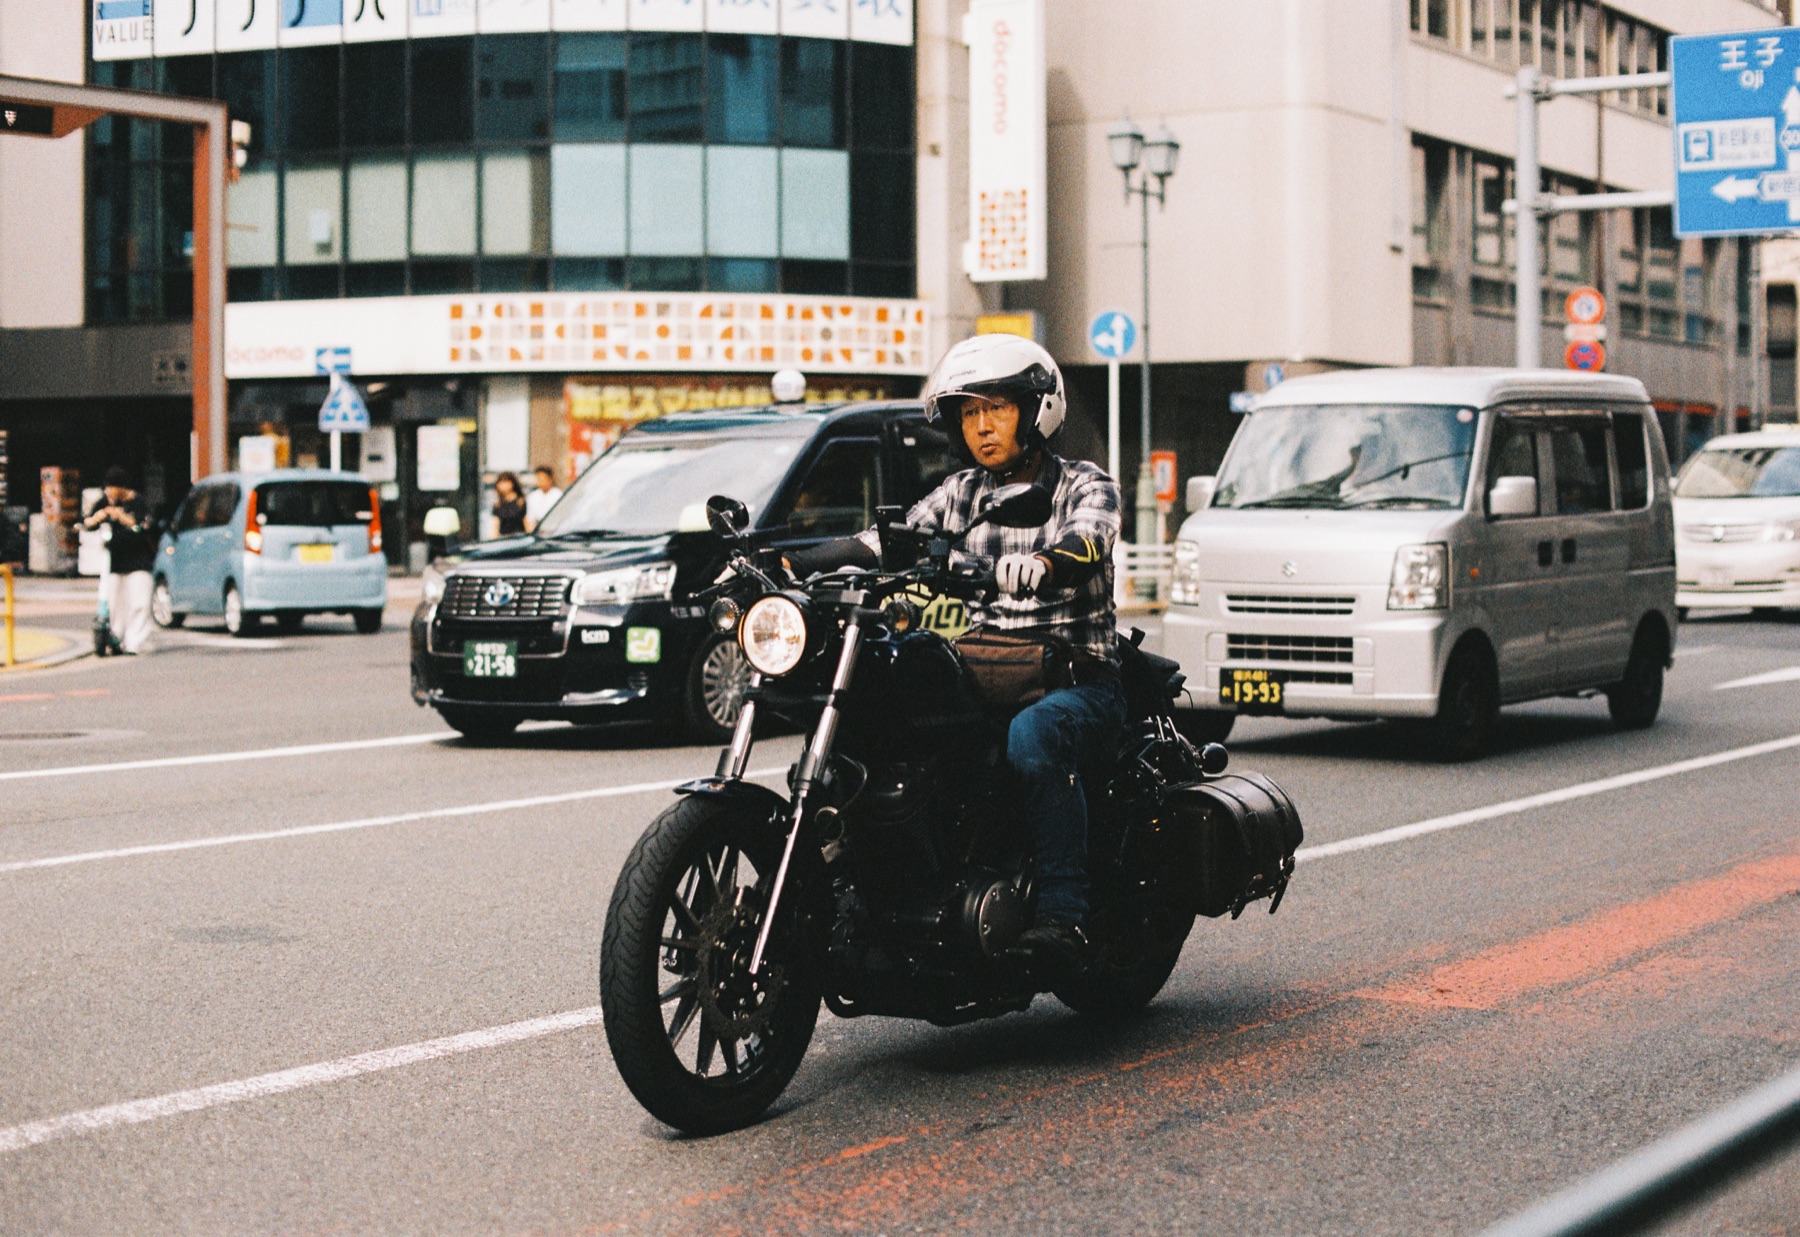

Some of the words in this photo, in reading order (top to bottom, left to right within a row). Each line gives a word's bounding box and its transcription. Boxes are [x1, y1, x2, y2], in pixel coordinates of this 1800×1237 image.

[94, 20, 150, 43] VALUE
[1721, 37, 1783, 70] 王子
[993, 21, 1012, 134] docomo
[1740, 70, 1763, 89] Oji
[474, 655, 516, 676] 21-58
[1234, 682, 1280, 703] 19-93
